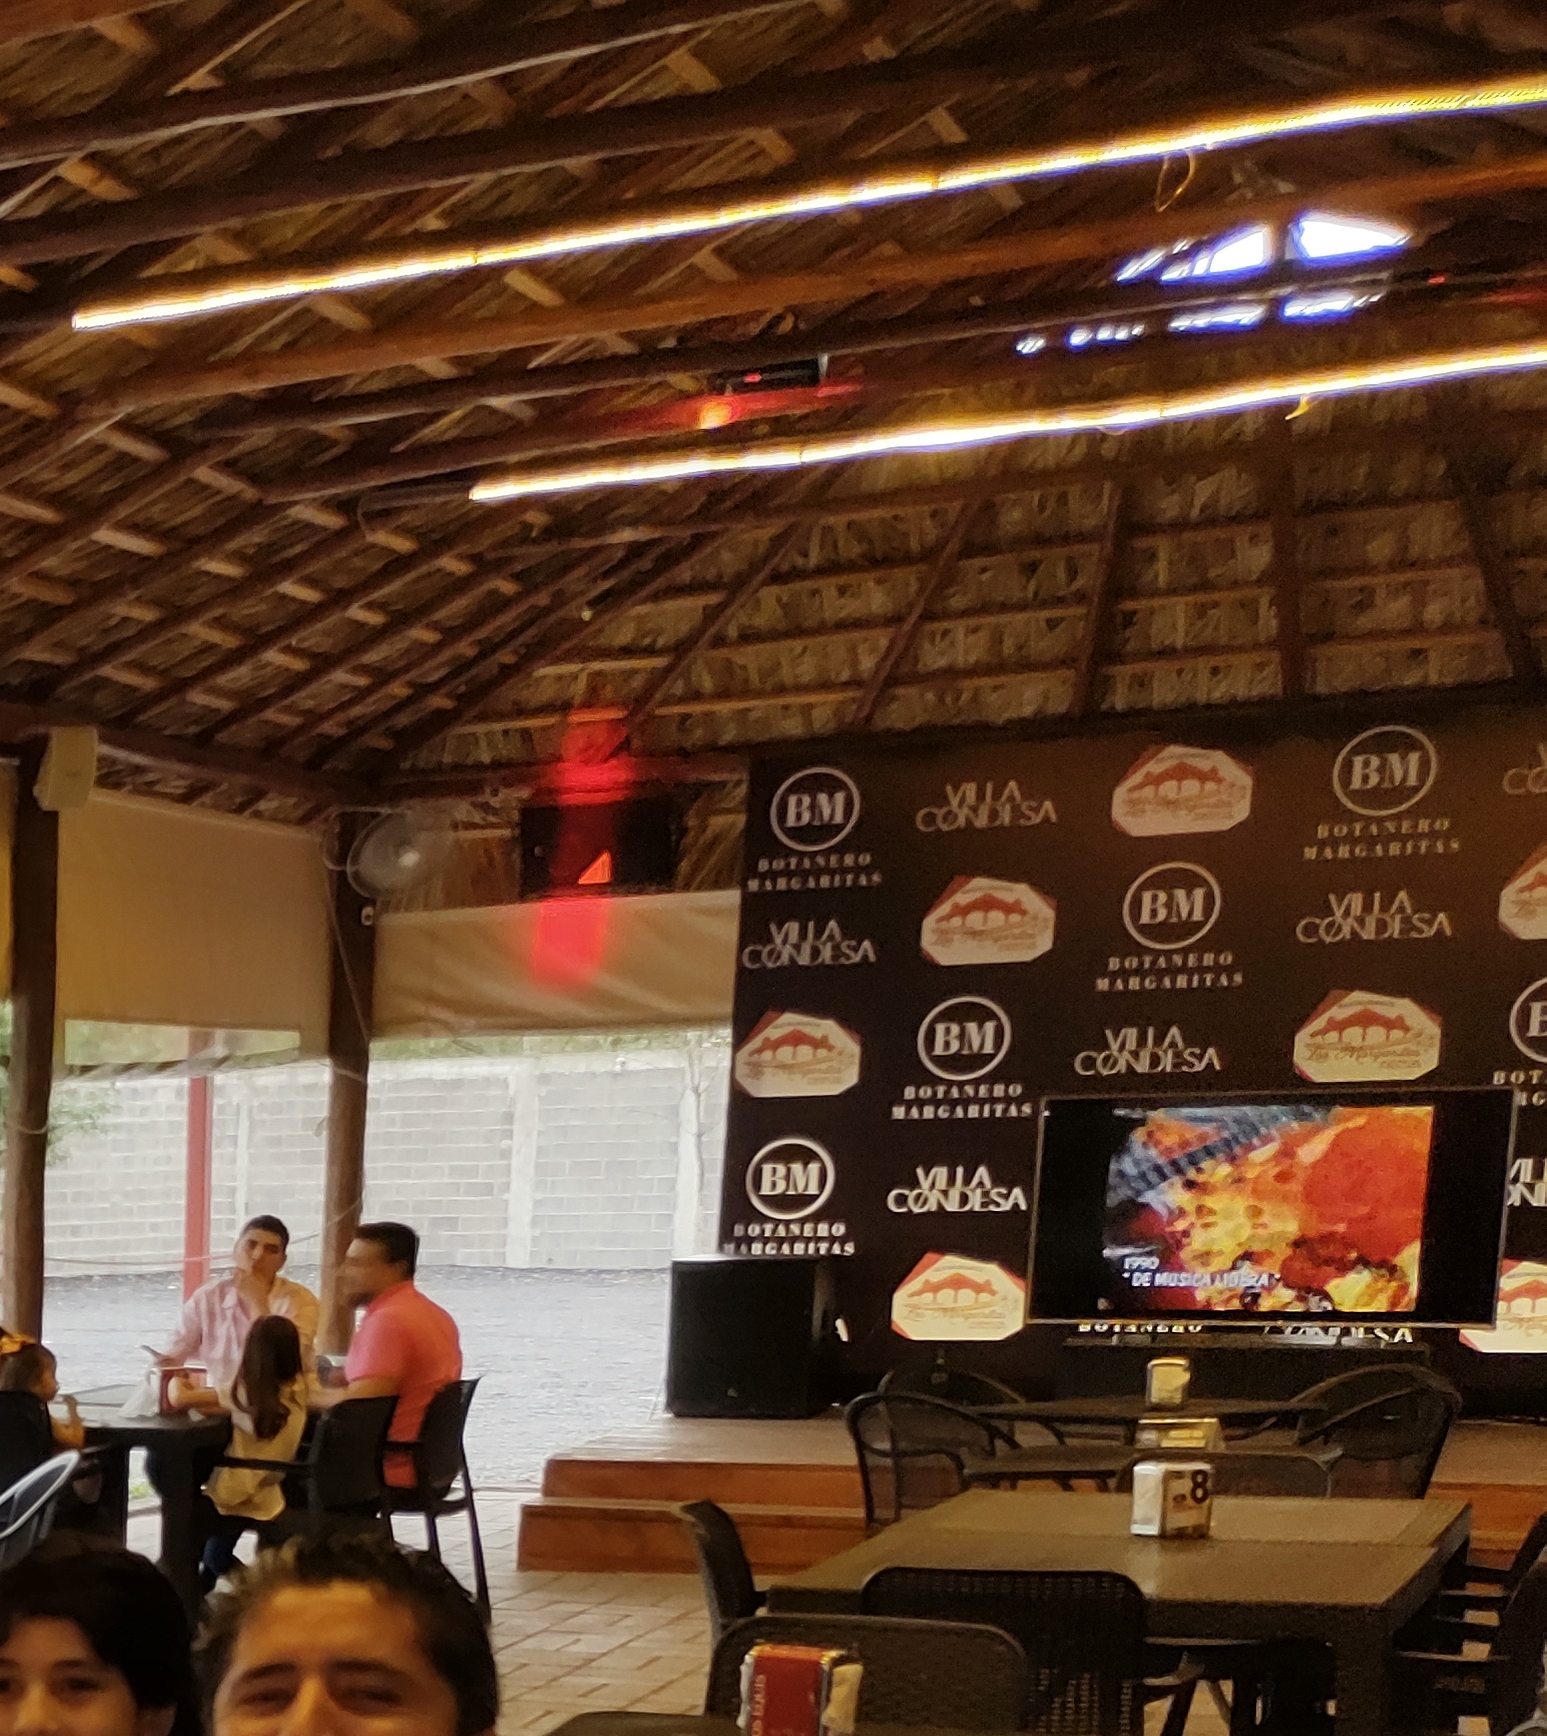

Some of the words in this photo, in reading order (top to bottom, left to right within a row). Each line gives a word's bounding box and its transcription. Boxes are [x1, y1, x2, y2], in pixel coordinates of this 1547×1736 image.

[1349, 751, 1422, 791] BM
[945, 779, 1022, 805] VILLA
[784, 792, 846, 828] BM
[1317, 818, 1451, 839] BOTANERO
[1138, 887, 1207, 925] BM
[1328, 890, 1414, 918] VILLA
[769, 919, 843, 945] VILLA
[1296, 912, 1453, 944] CONDESA
[1107, 951, 1234, 972] BOTANERO
[1095, 971, 1244, 992] MARGARITAS
[932, 1021, 998, 1056] BM
[1106, 1025, 1184, 1052] VILLA
[1074, 1048, 1222, 1077] CONDESA
[904, 1084, 1023, 1100] BOTANERO
[891, 1102, 1033, 1120] MARGARITAS
[759, 1163, 822, 1196] BM
[915, 1164, 992, 1190] VILLA
[887, 1187, 1028, 1213] CONDESA
[733, 1222, 846, 1238] BOTANERO
[722, 1242, 856, 1257] MARGARITAS
[1191, 1469, 1210, 1504] 8
